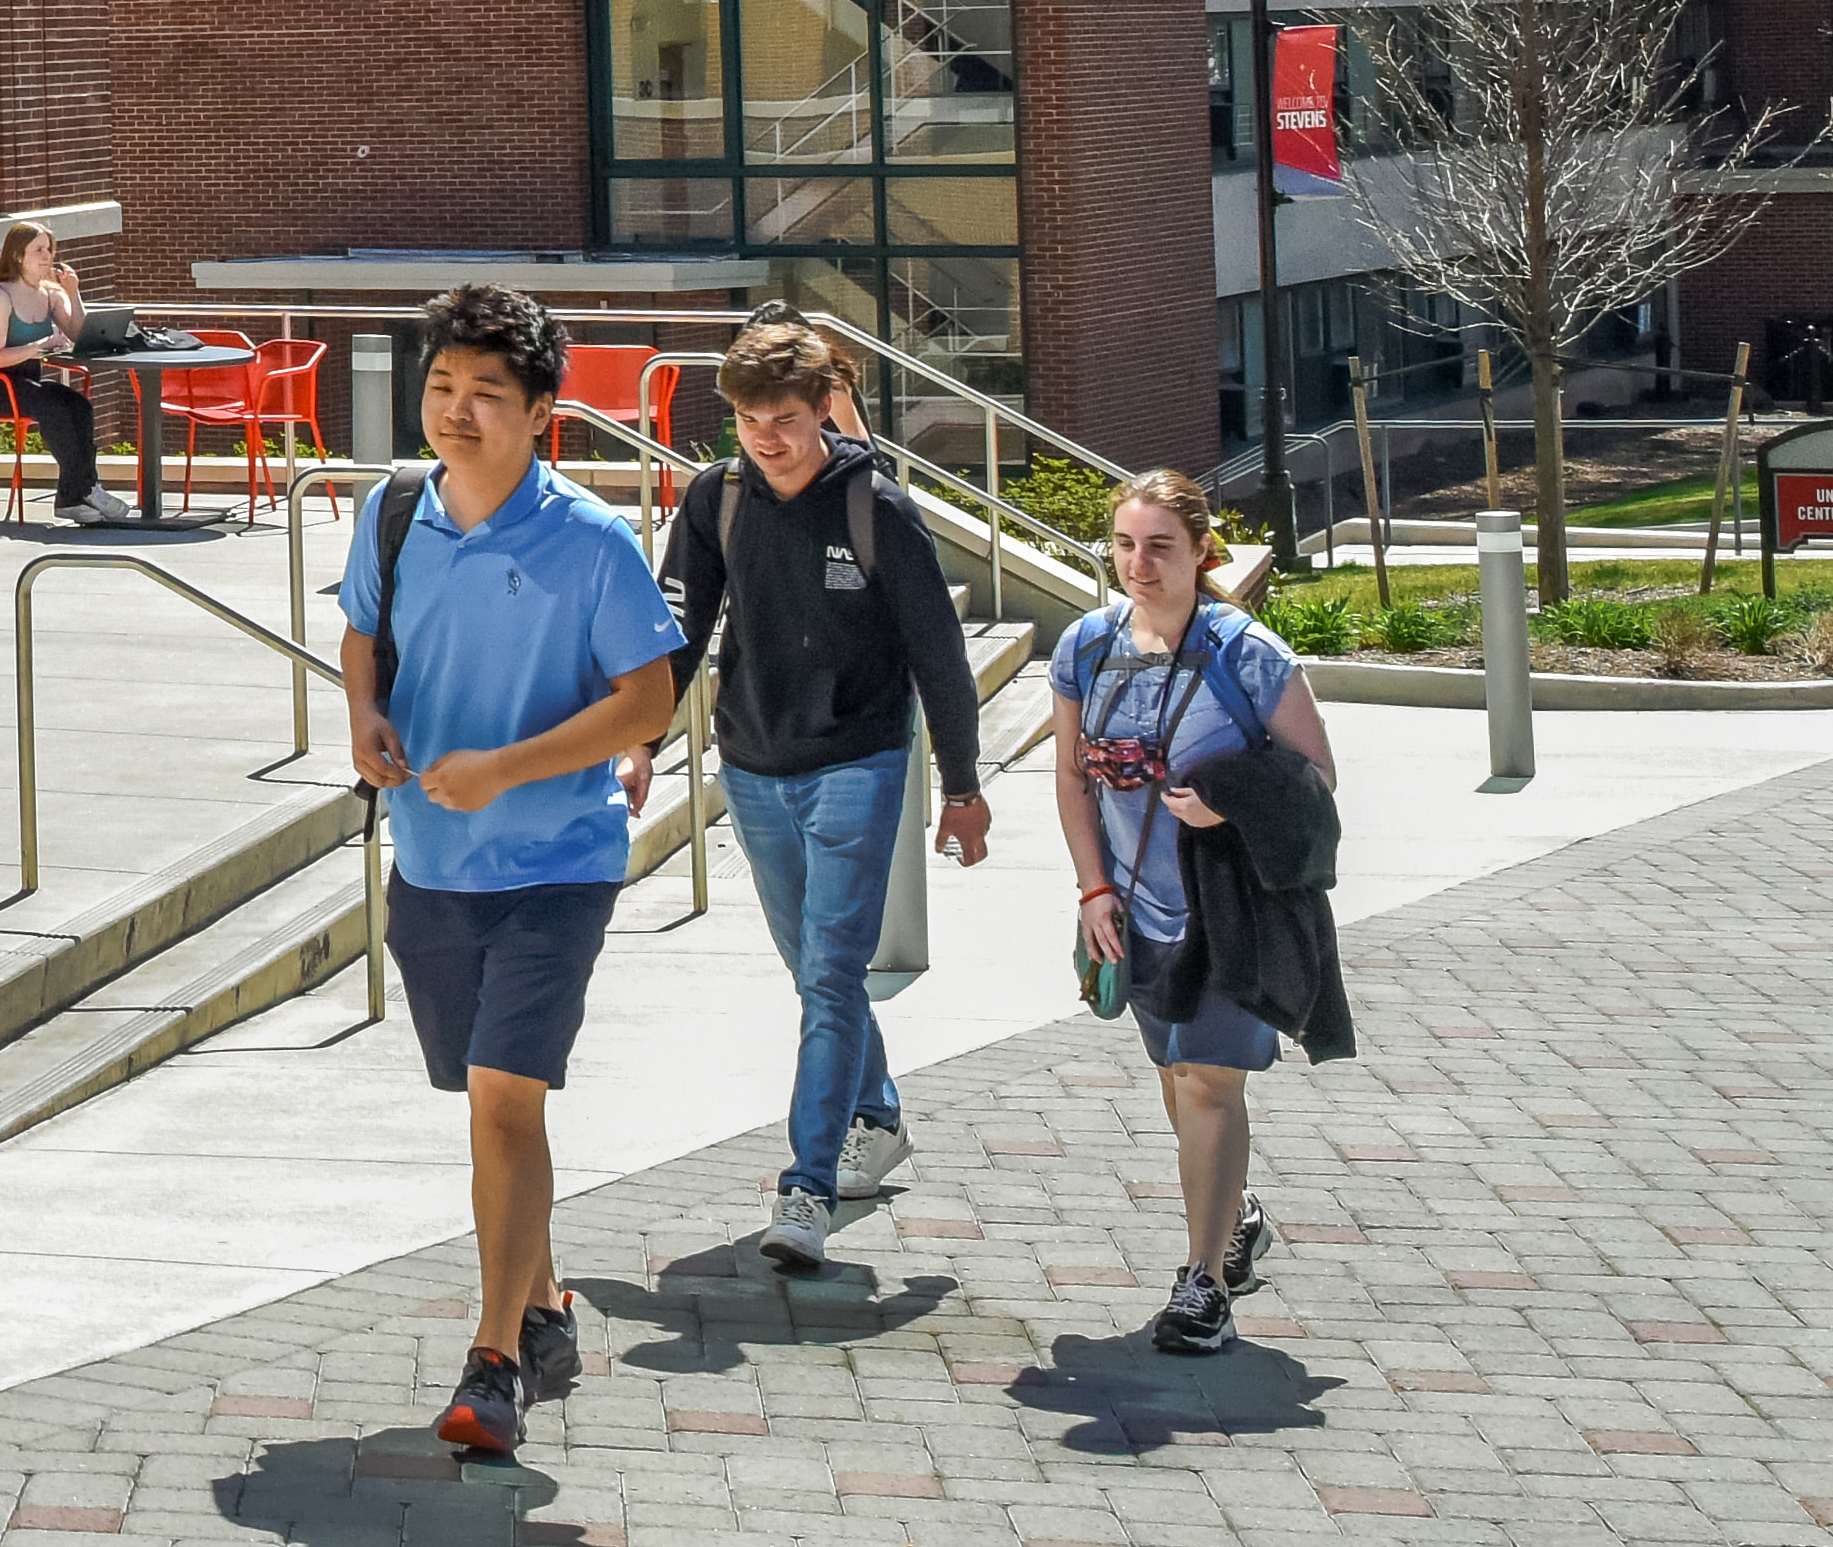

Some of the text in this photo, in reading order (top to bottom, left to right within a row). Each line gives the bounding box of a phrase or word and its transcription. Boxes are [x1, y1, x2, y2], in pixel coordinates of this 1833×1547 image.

[1277, 95, 1328, 110] WELCOME TO
[1276, 109, 1327, 130] STEVENS
[1797, 506, 1833, 521] CENT
